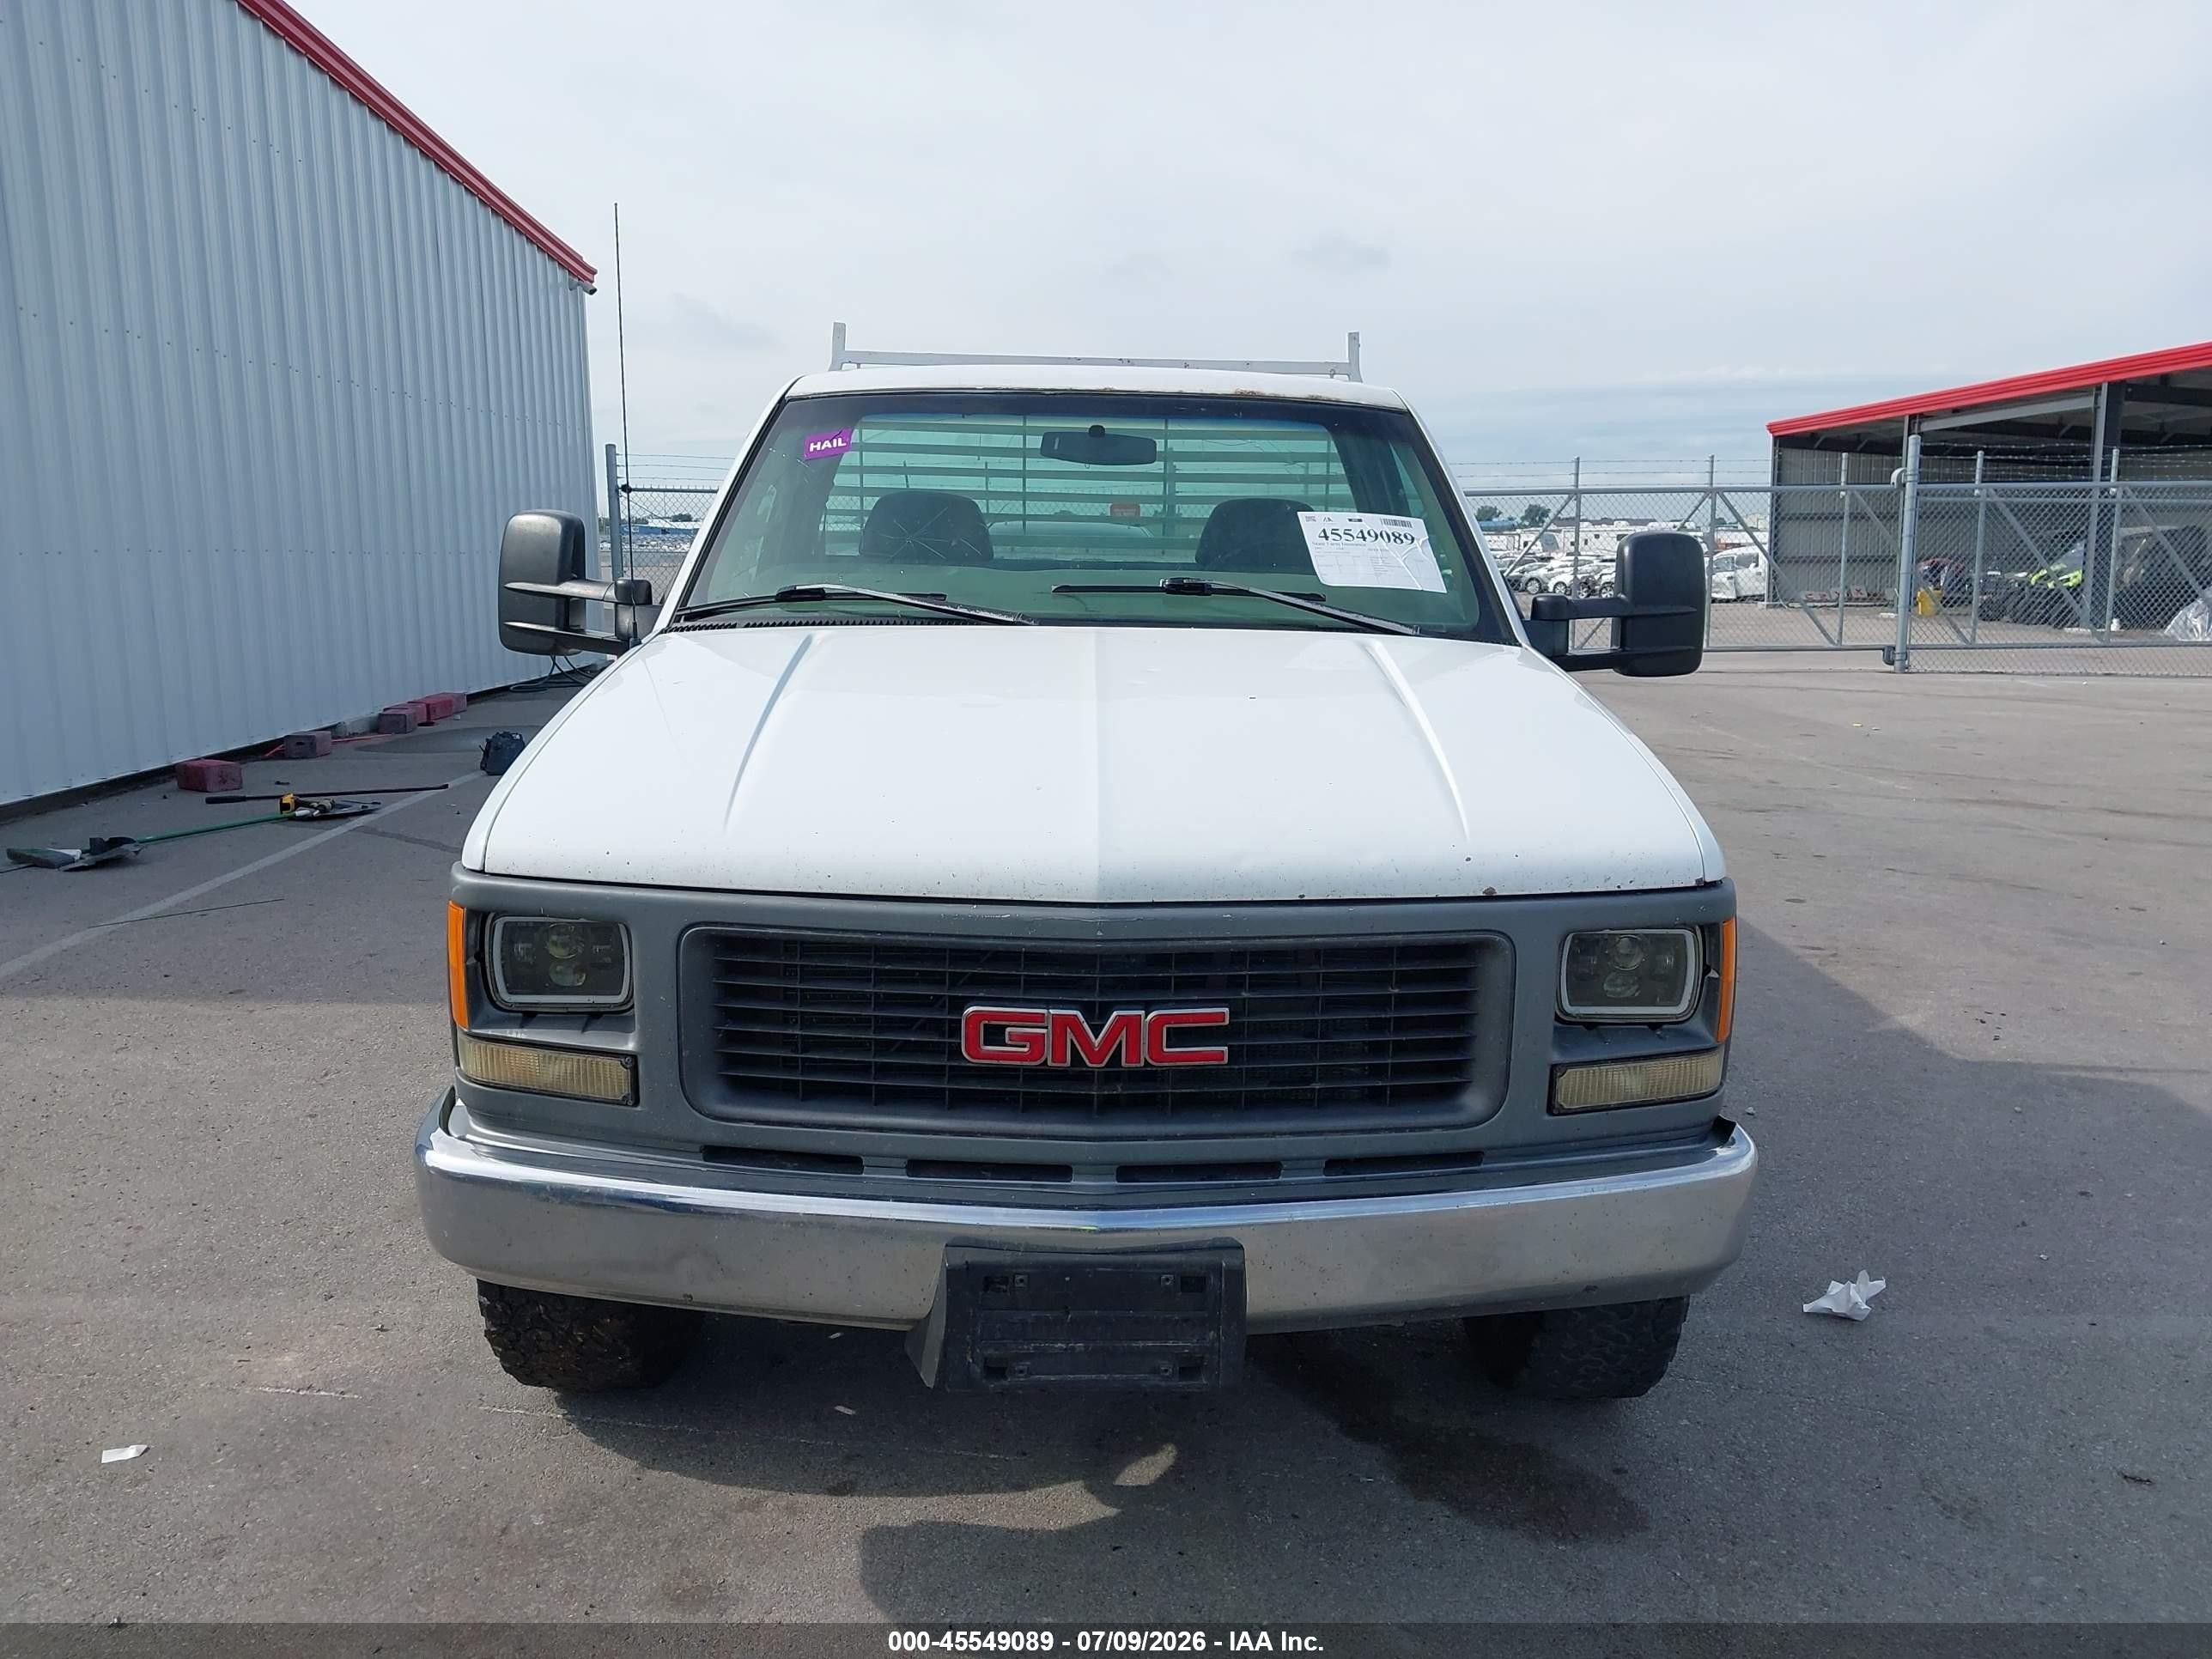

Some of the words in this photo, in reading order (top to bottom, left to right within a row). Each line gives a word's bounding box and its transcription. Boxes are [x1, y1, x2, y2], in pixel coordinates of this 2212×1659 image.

[809, 437, 847, 453] HAIL
[1318, 527, 1415, 545] 45549089
[961, 1006, 1230, 1067] GMC
